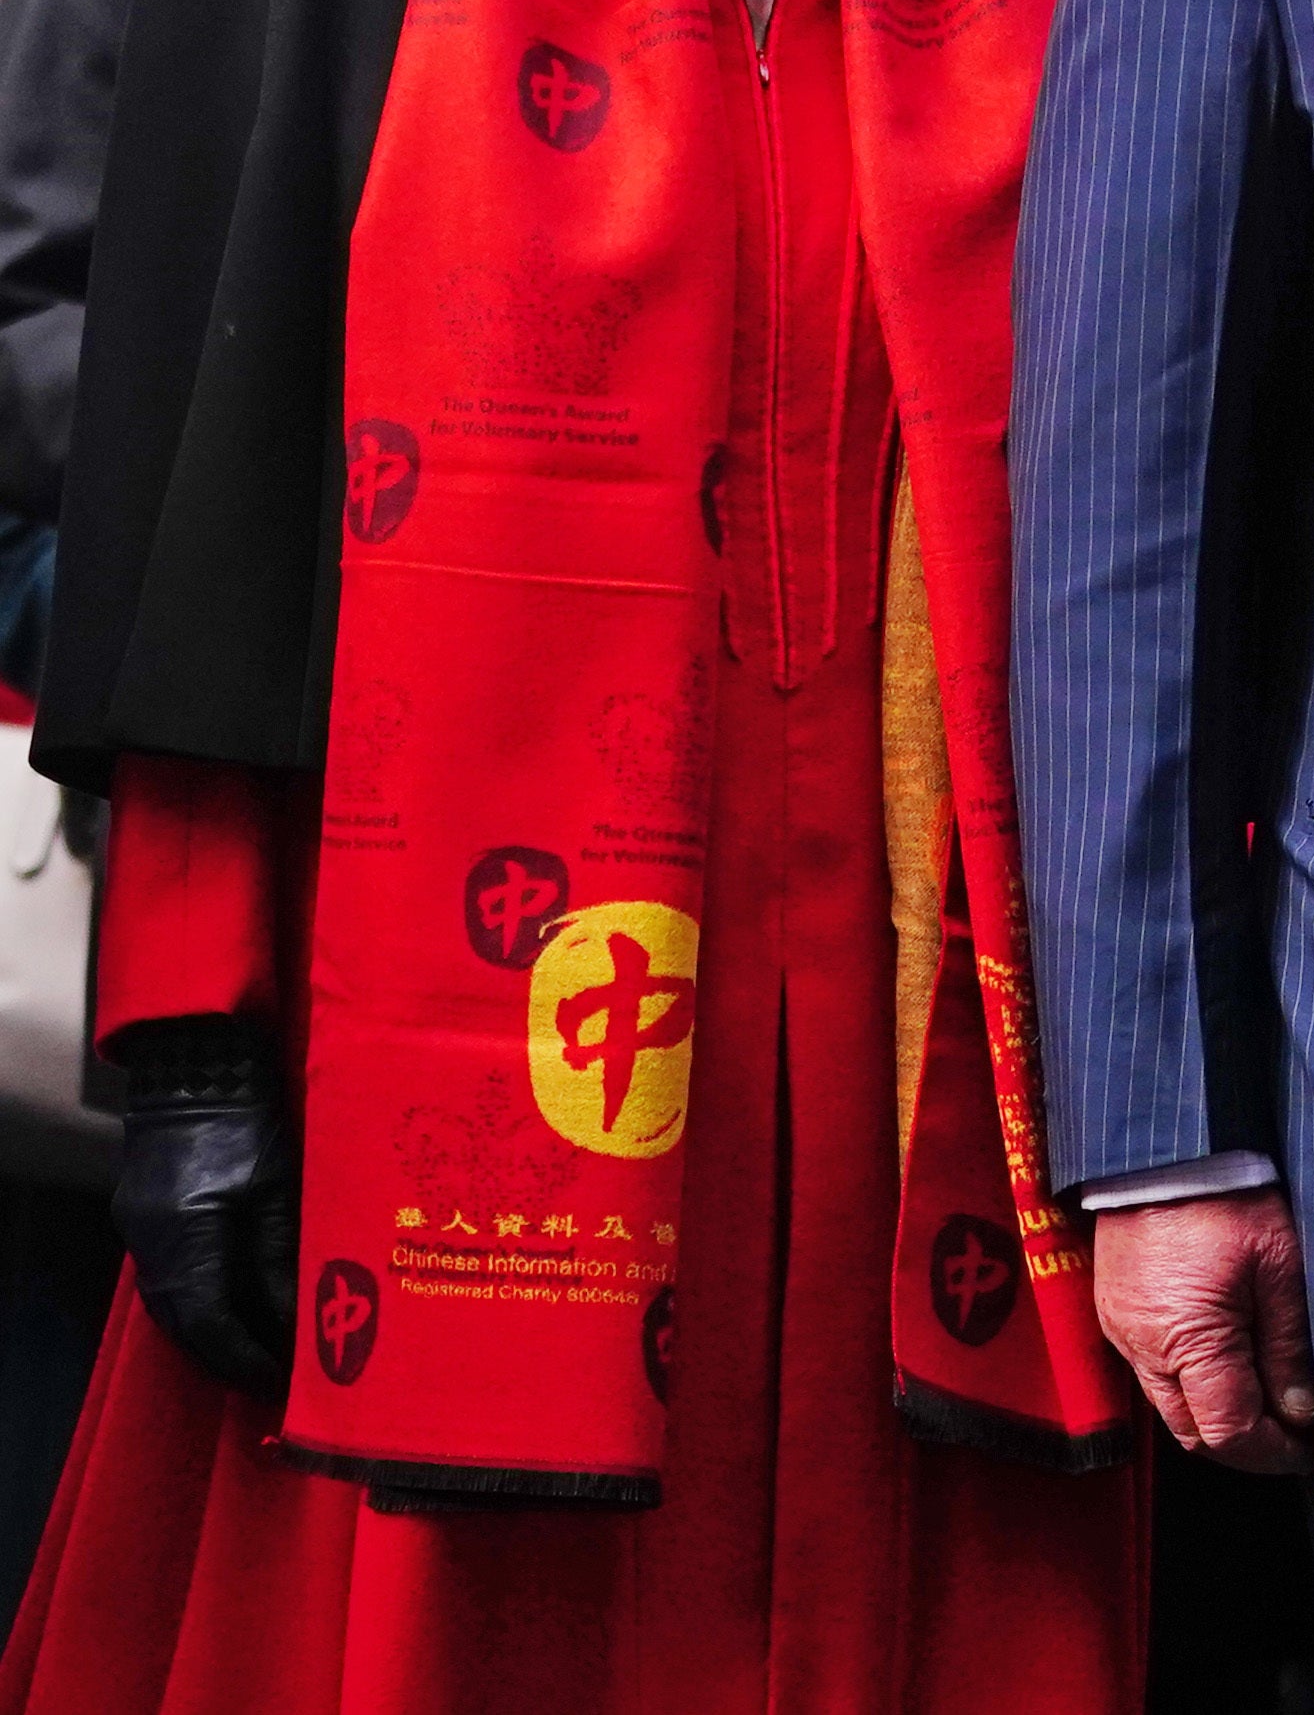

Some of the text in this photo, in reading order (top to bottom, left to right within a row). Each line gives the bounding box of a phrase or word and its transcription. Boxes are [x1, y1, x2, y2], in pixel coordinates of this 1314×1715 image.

[553, 929, 698, 1137] 中
[392, 1245, 481, 1272] Chinese
[487, 1252, 617, 1279] Information
[400, 1276, 494, 1300] Registered
[498, 1282, 562, 1304] Charity
